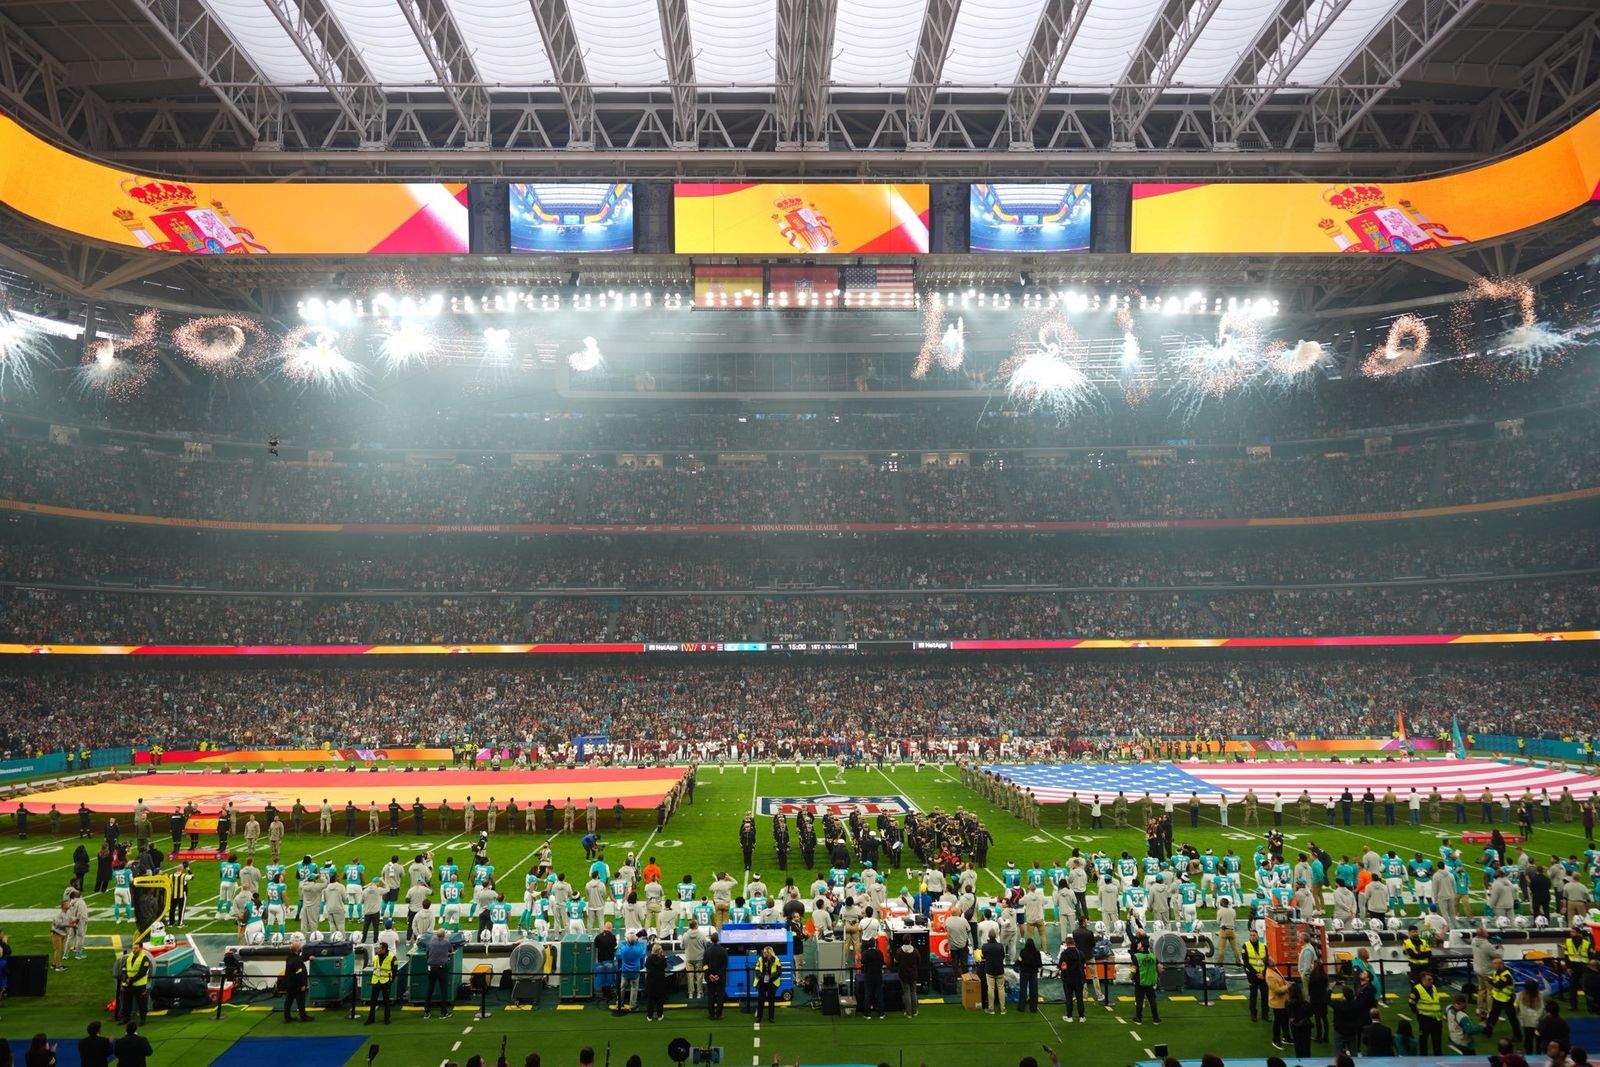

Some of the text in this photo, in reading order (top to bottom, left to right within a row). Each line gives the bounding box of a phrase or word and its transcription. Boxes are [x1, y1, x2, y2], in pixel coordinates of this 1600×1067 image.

[1123, 863, 1134, 873] 22
[1207, 860, 1214, 870] 3
[1388, 864, 1401, 875] 90
[222, 867, 234, 878] 70
[346, 869, 358, 880] 79
[440, 870, 451, 880] 71
[475, 870, 487, 880] 72
[115, 874, 125, 885] 16
[1034, 874, 1041, 885] 0
[445, 888, 458, 899] 89
[614, 883, 624, 894] 18
[680, 888, 692, 899] 84
[1281, 895, 1288, 907] 8
[492, 909, 506, 921] 30
[571, 907, 579, 918] 5
[697, 912, 709, 924] 19
[733, 912, 745, 923] 17
